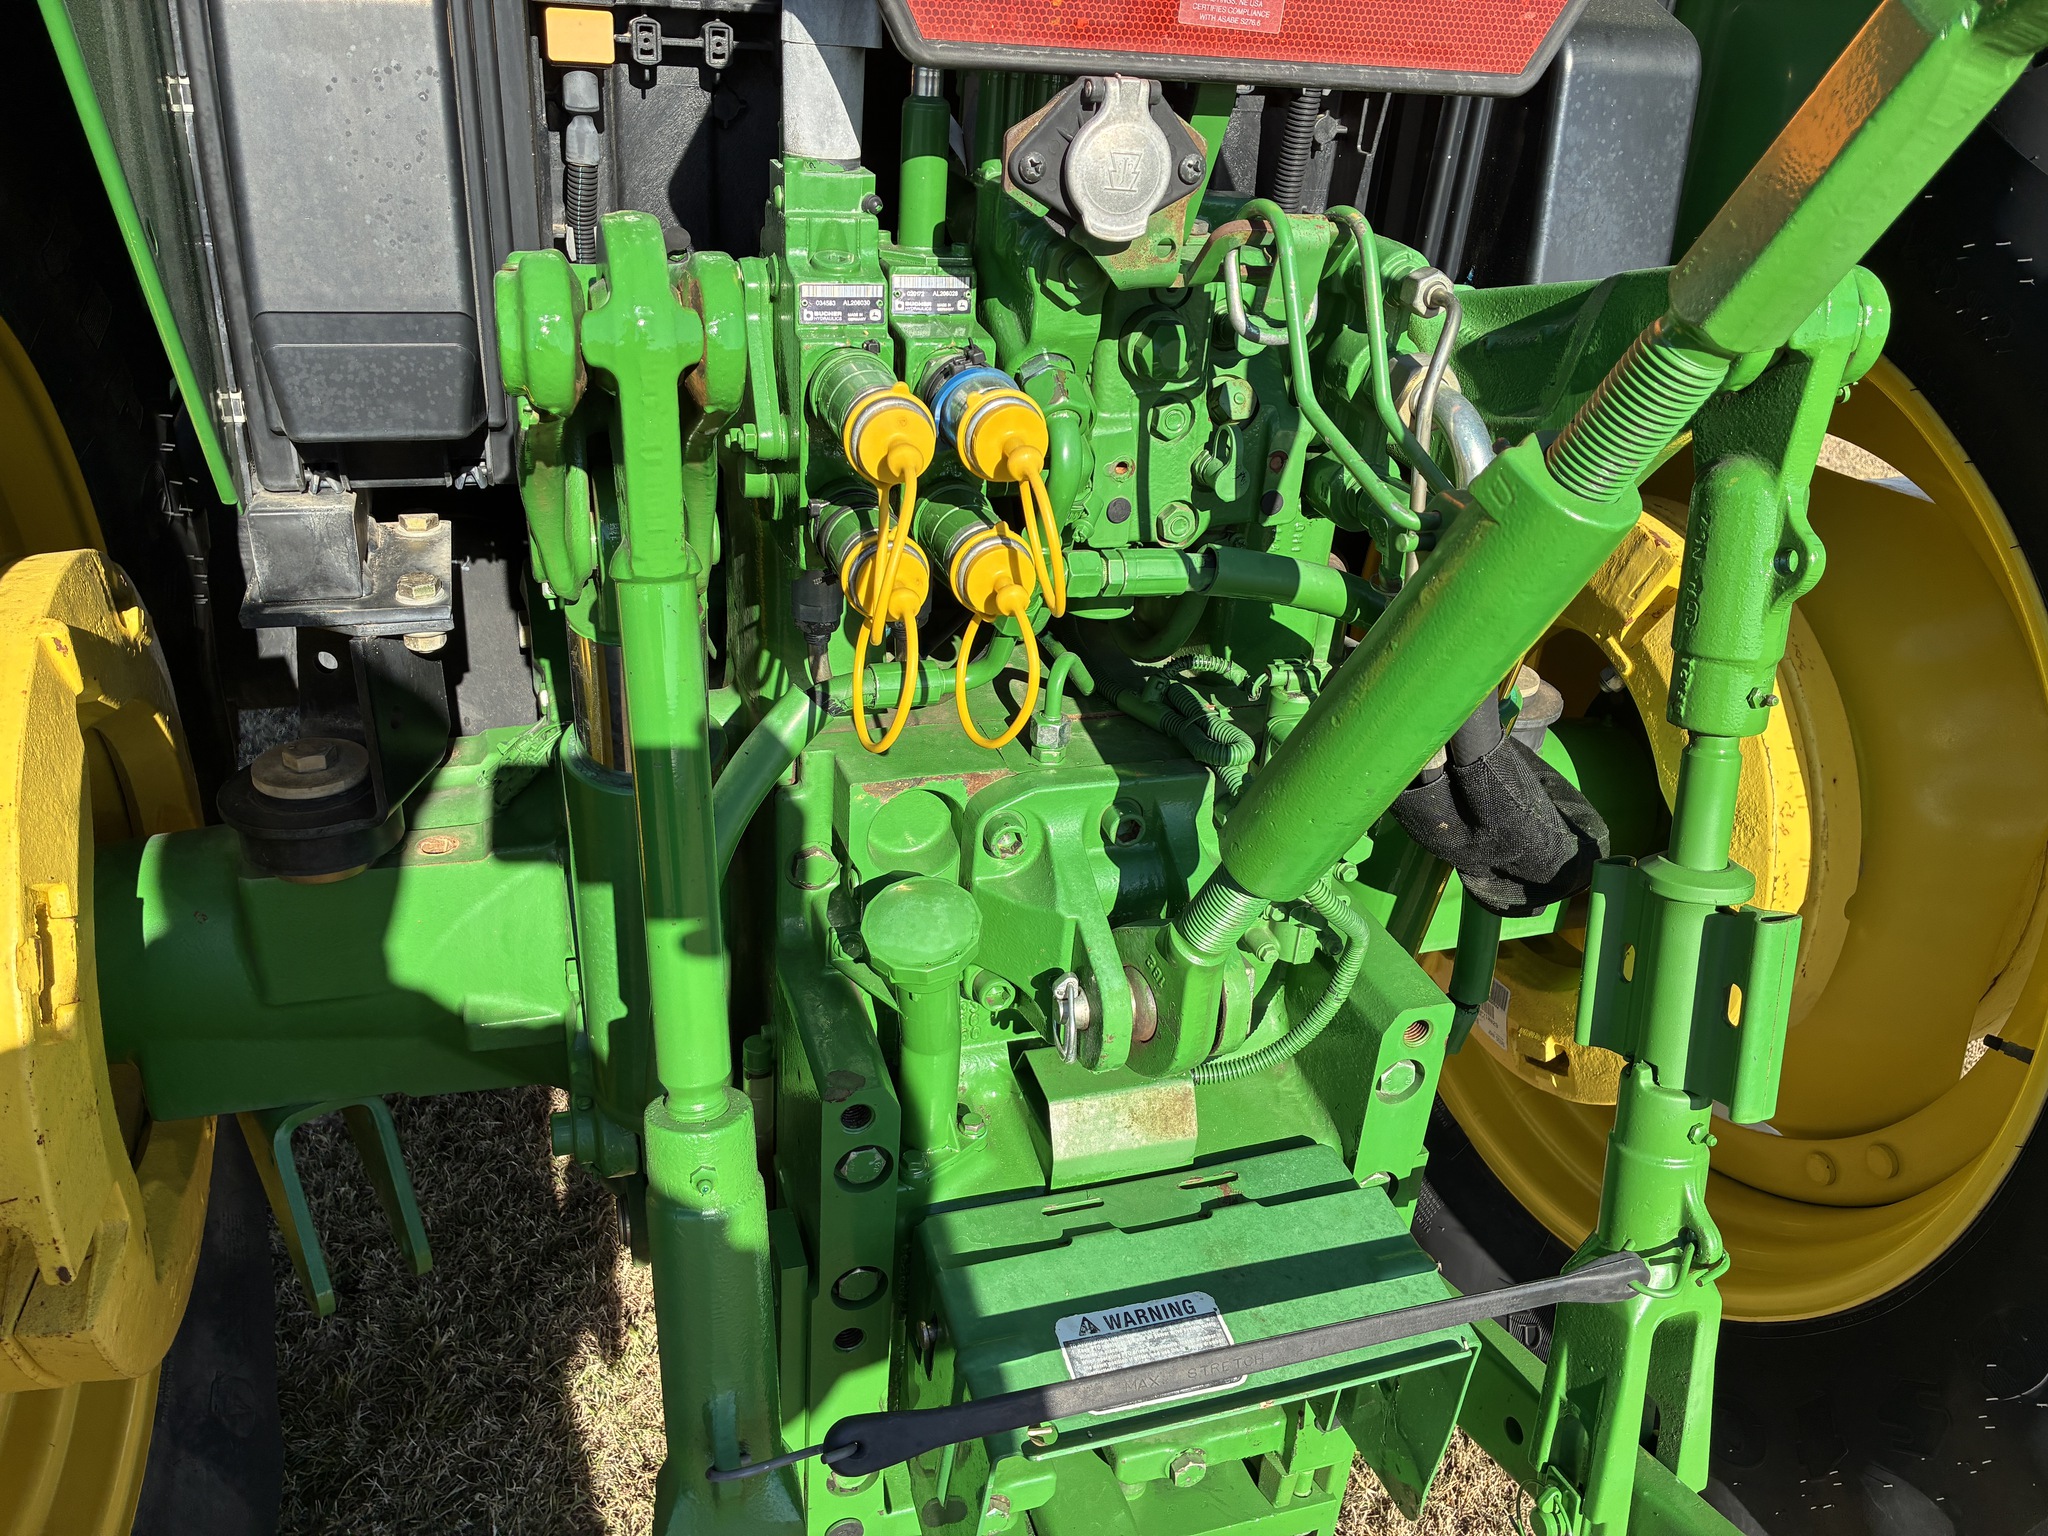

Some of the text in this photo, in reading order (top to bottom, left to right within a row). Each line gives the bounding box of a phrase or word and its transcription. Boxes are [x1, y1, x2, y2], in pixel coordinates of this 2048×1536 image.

[1192, 2, 1271, 18] CERTIFIES COMPLIANCE
[1249, 0, 1263, 8] USA
[1199, 12, 1216, 21] WITH
[1217, 15, 1239, 25] ASABE
[1103, 1299, 1197, 1331] WARNING
[1186, 1354, 1265, 1380] STRETCH
